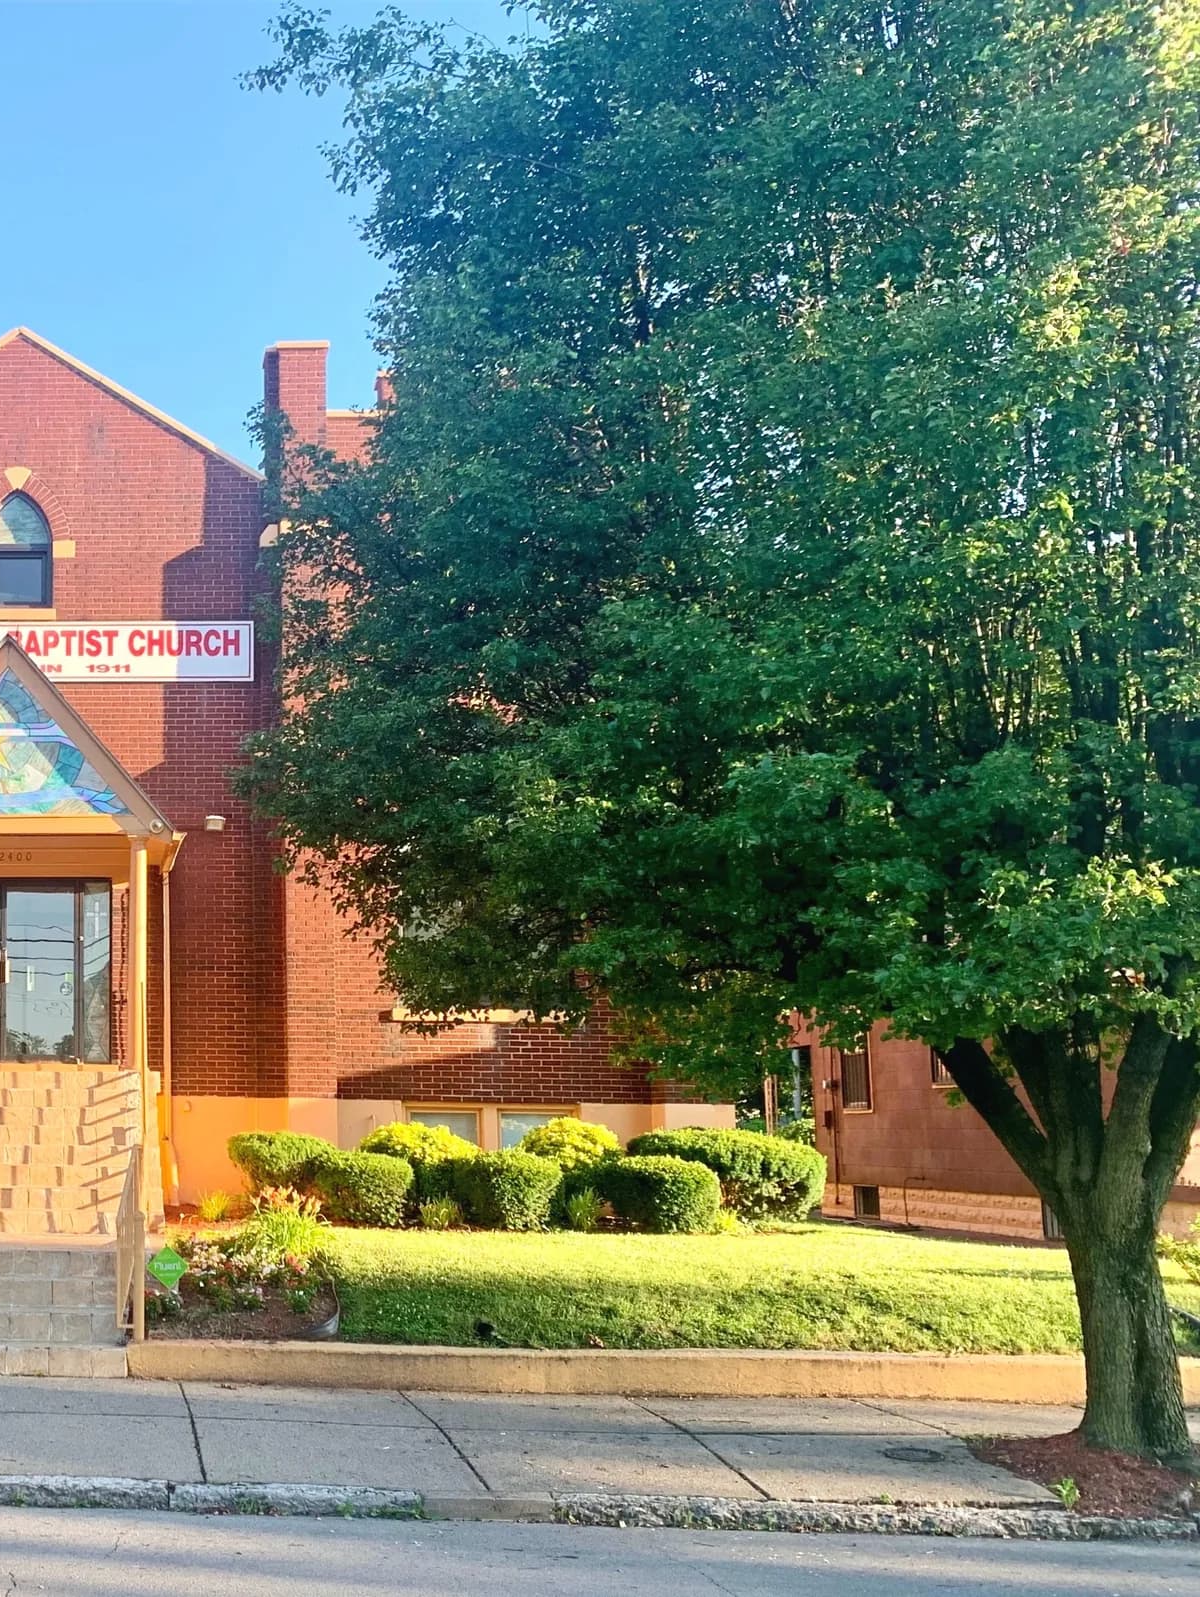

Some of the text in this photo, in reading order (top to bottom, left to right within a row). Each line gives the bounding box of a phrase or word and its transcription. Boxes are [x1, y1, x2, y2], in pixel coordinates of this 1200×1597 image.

[127, 629, 241, 657] CHURCH
[41, 664, 62, 673] IN
[85, 664, 131, 673] 1911
[0, 852, 32, 862] 2400
